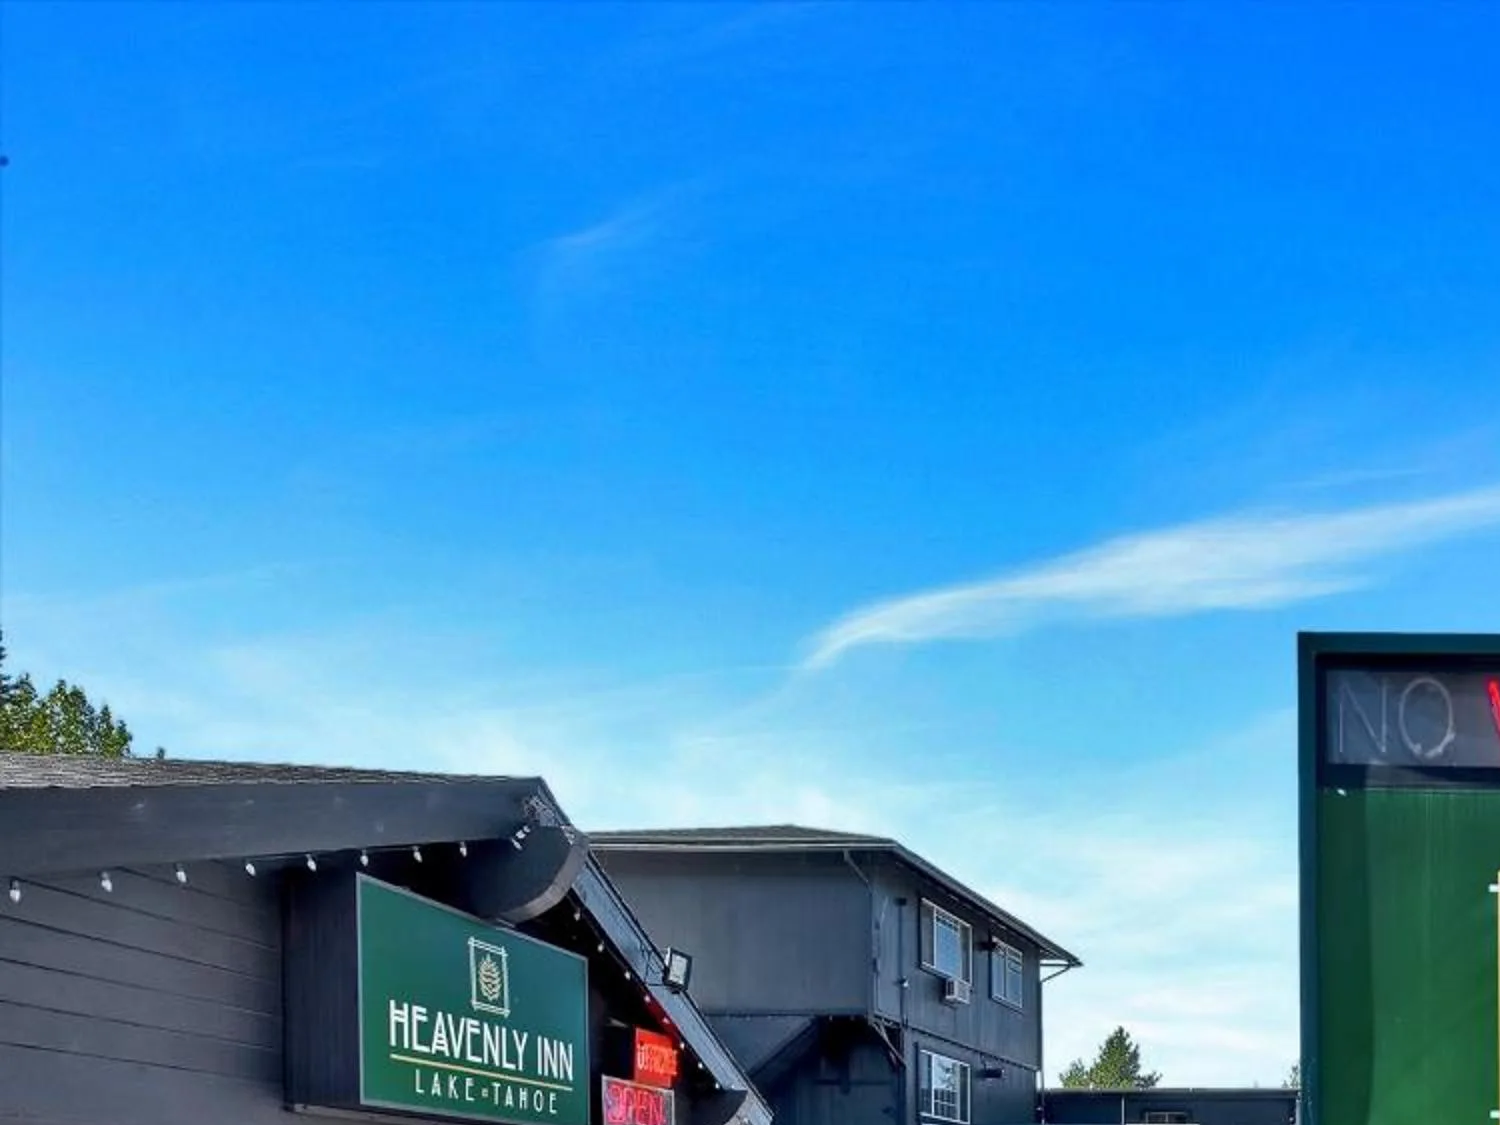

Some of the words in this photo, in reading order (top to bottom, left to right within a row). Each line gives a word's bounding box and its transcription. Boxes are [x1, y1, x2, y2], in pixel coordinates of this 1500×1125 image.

[1339, 677, 1456, 758] NO
[389, 999, 528, 1072] HEAVENLY
[537, 1025, 574, 1082] INN
[415, 1068, 476, 1102] LAKE
[491, 1081, 558, 1115] TAHOE
